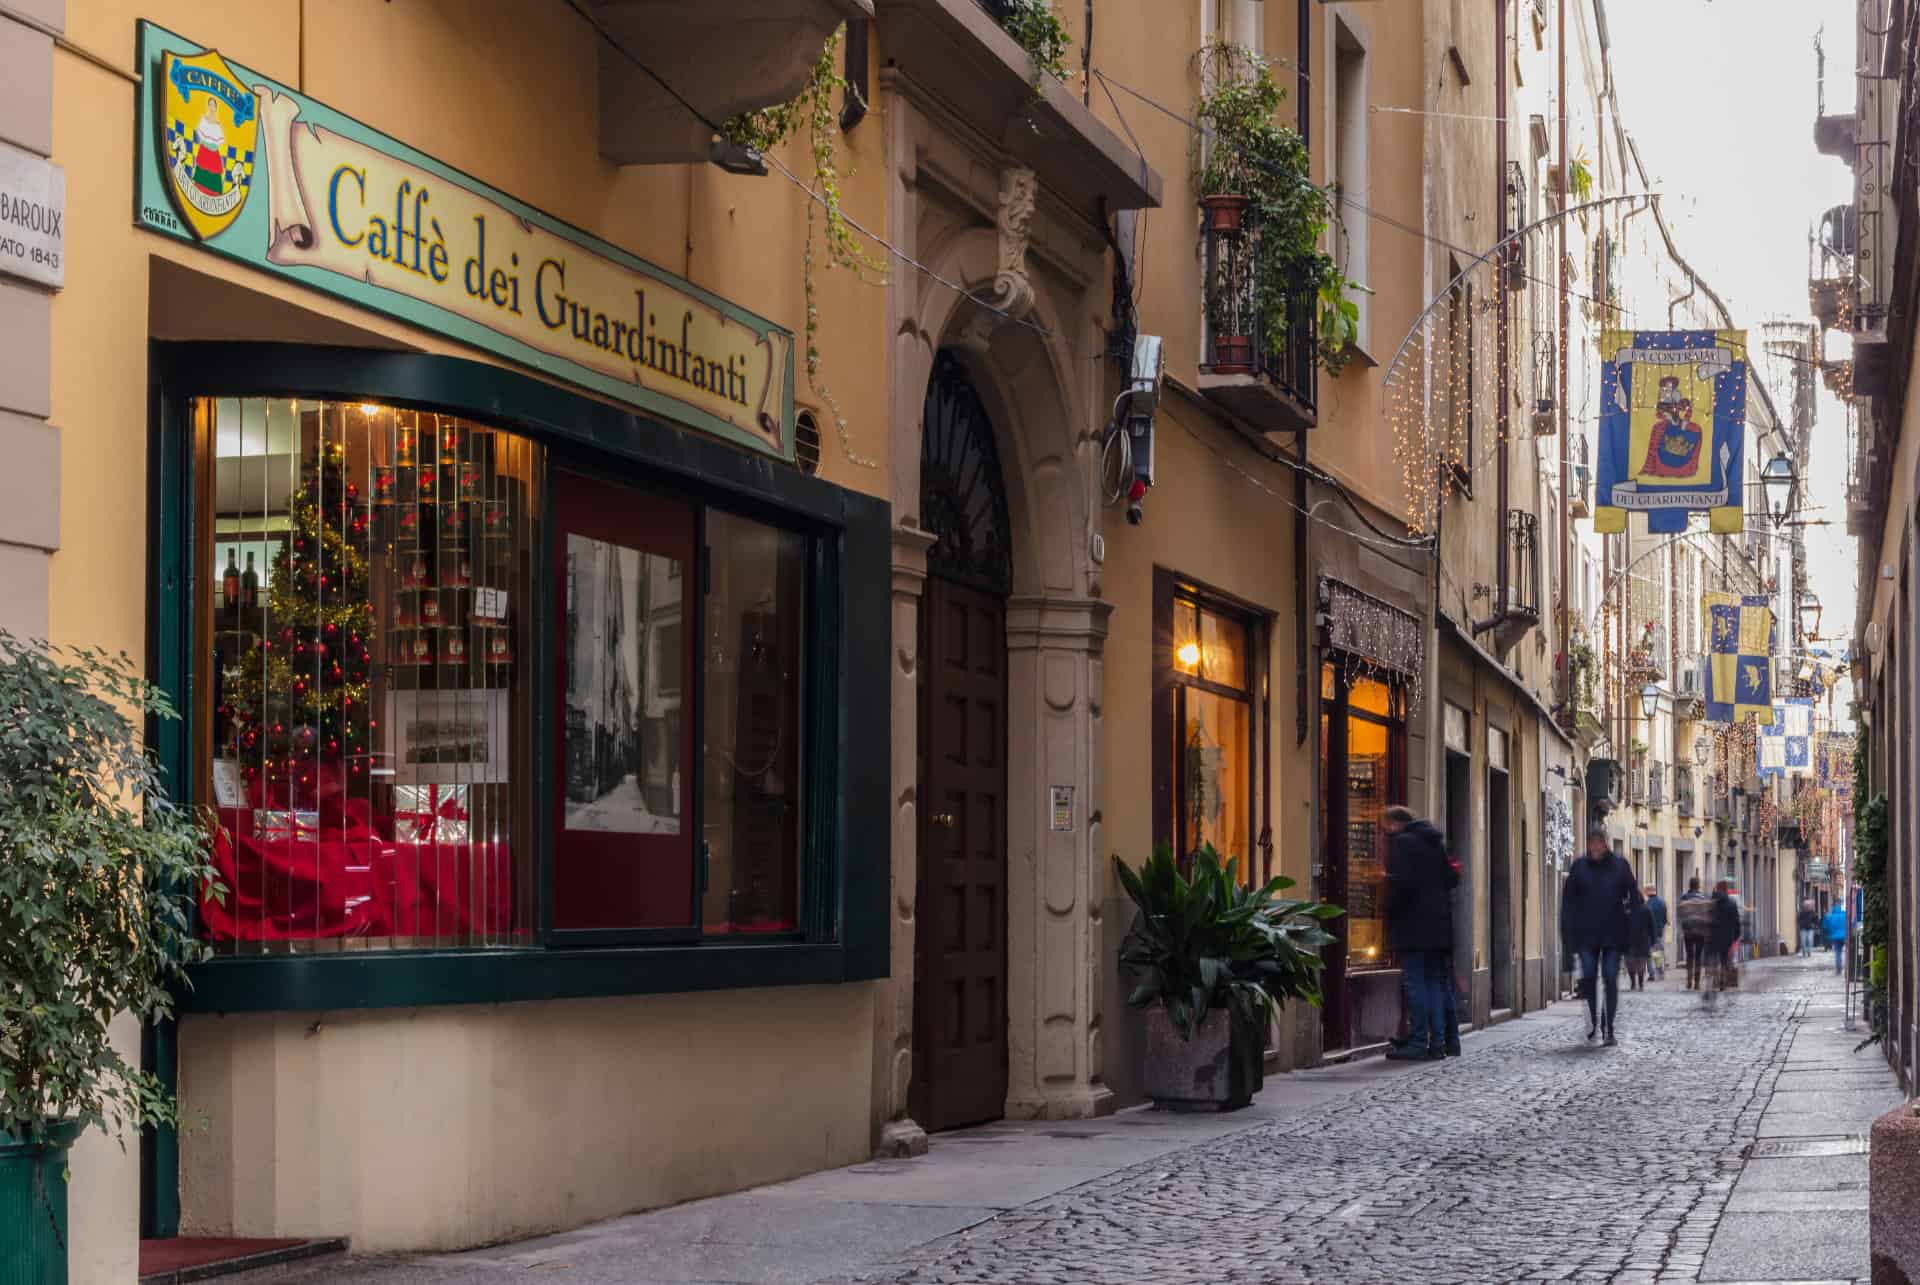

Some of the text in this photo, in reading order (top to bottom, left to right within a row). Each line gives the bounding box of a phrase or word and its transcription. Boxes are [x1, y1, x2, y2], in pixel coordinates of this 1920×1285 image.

[1, 192, 61, 240] BAROUX
[0, 235, 59, 269] ATO 1843
[328, 166, 748, 407] Caffè dei Guardinfanti
[1616, 494, 1634, 505] DEI
